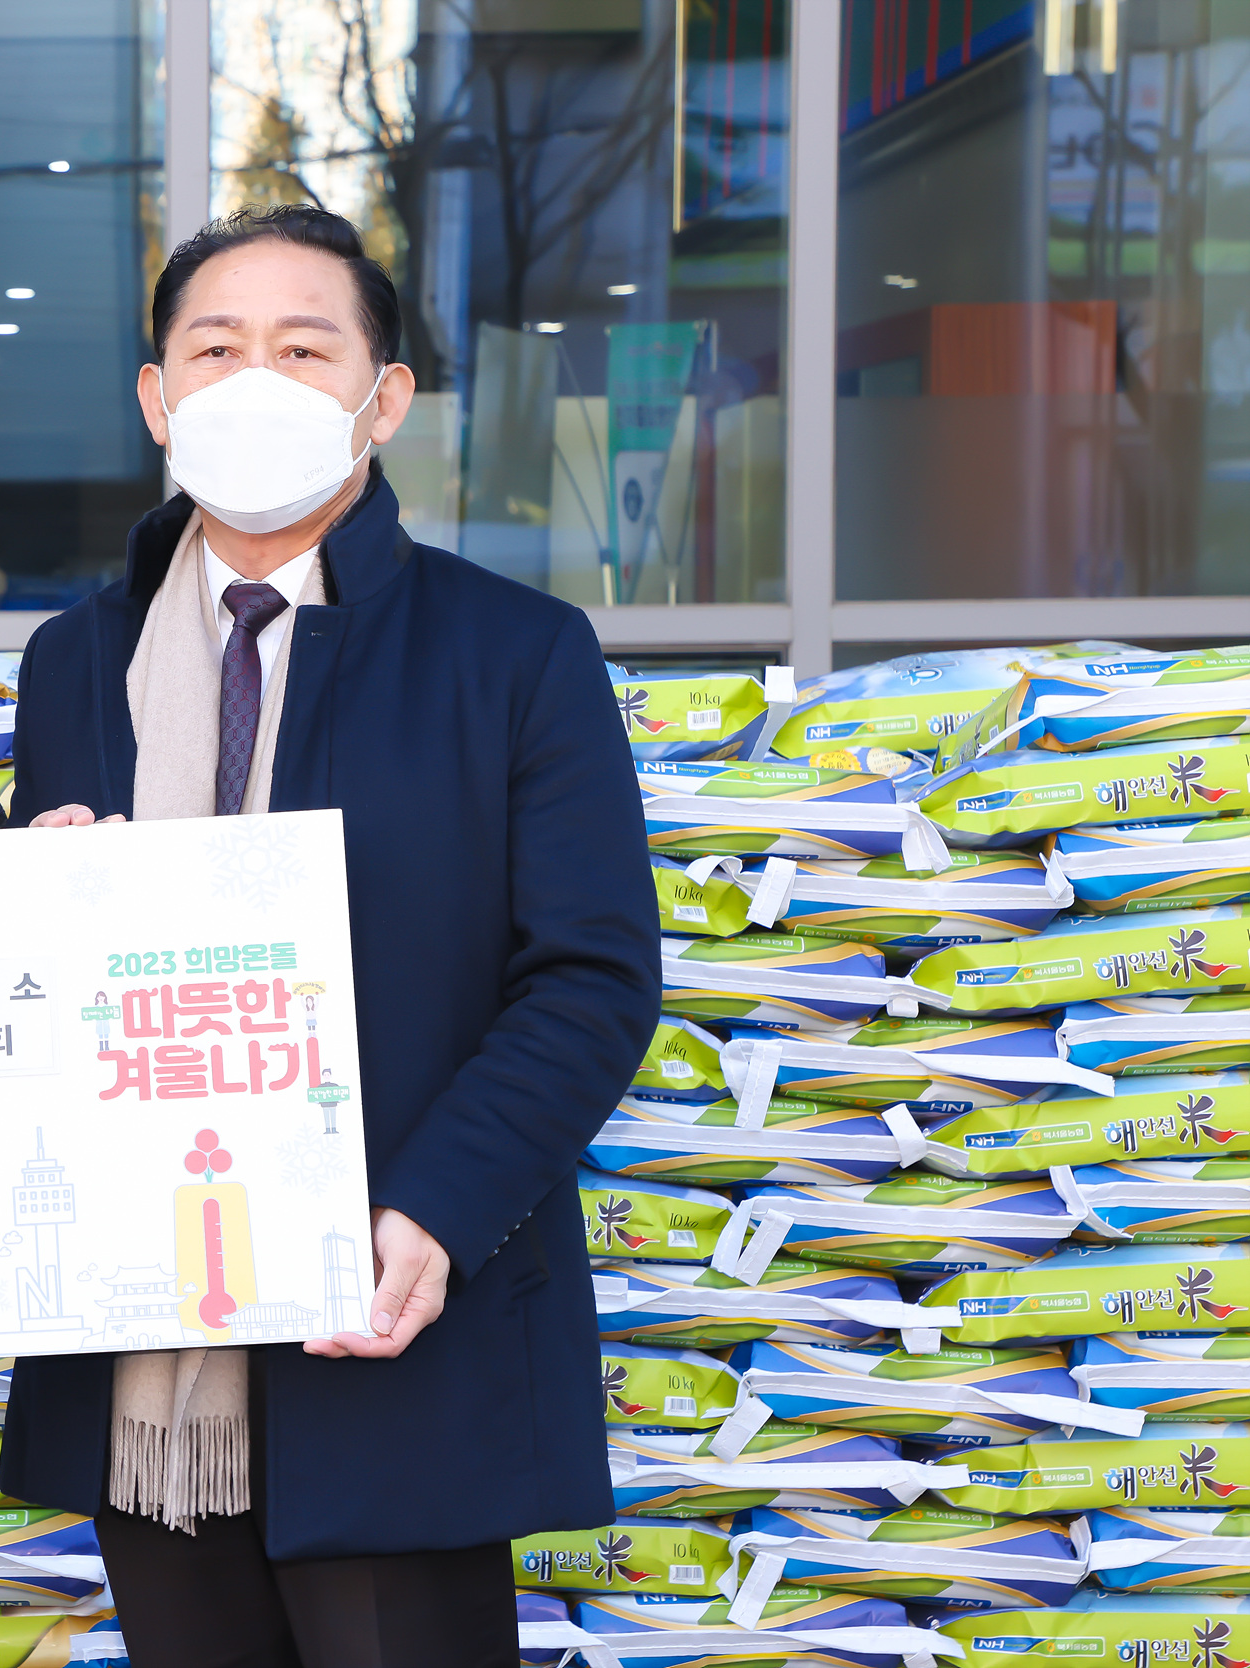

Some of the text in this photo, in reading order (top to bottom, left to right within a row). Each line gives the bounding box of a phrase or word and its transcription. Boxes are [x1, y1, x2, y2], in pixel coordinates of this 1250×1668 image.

[1092, 663, 1130, 678] NH
[689, 691, 721, 707] 10 kg
[810, 727, 831, 739] NH
[643, 761, 678, 774] NH
[962, 798, 987, 811] NH
[674, 885, 704, 904] 10 kg
[107, 942, 298, 977] 2023 희망온돌
[121, 977, 292, 1039] 따뜻한
[96, 1036, 322, 1102] 겨울나기
[970, 1135, 995, 1147] NH
[963, 1301, 987, 1314] NH
[667, 1374, 696, 1391] 10 kg
[971, 1473, 997, 1484] NH
[673, 1544, 700, 1562] 10 kg
[978, 1638, 1005, 1650] NH
